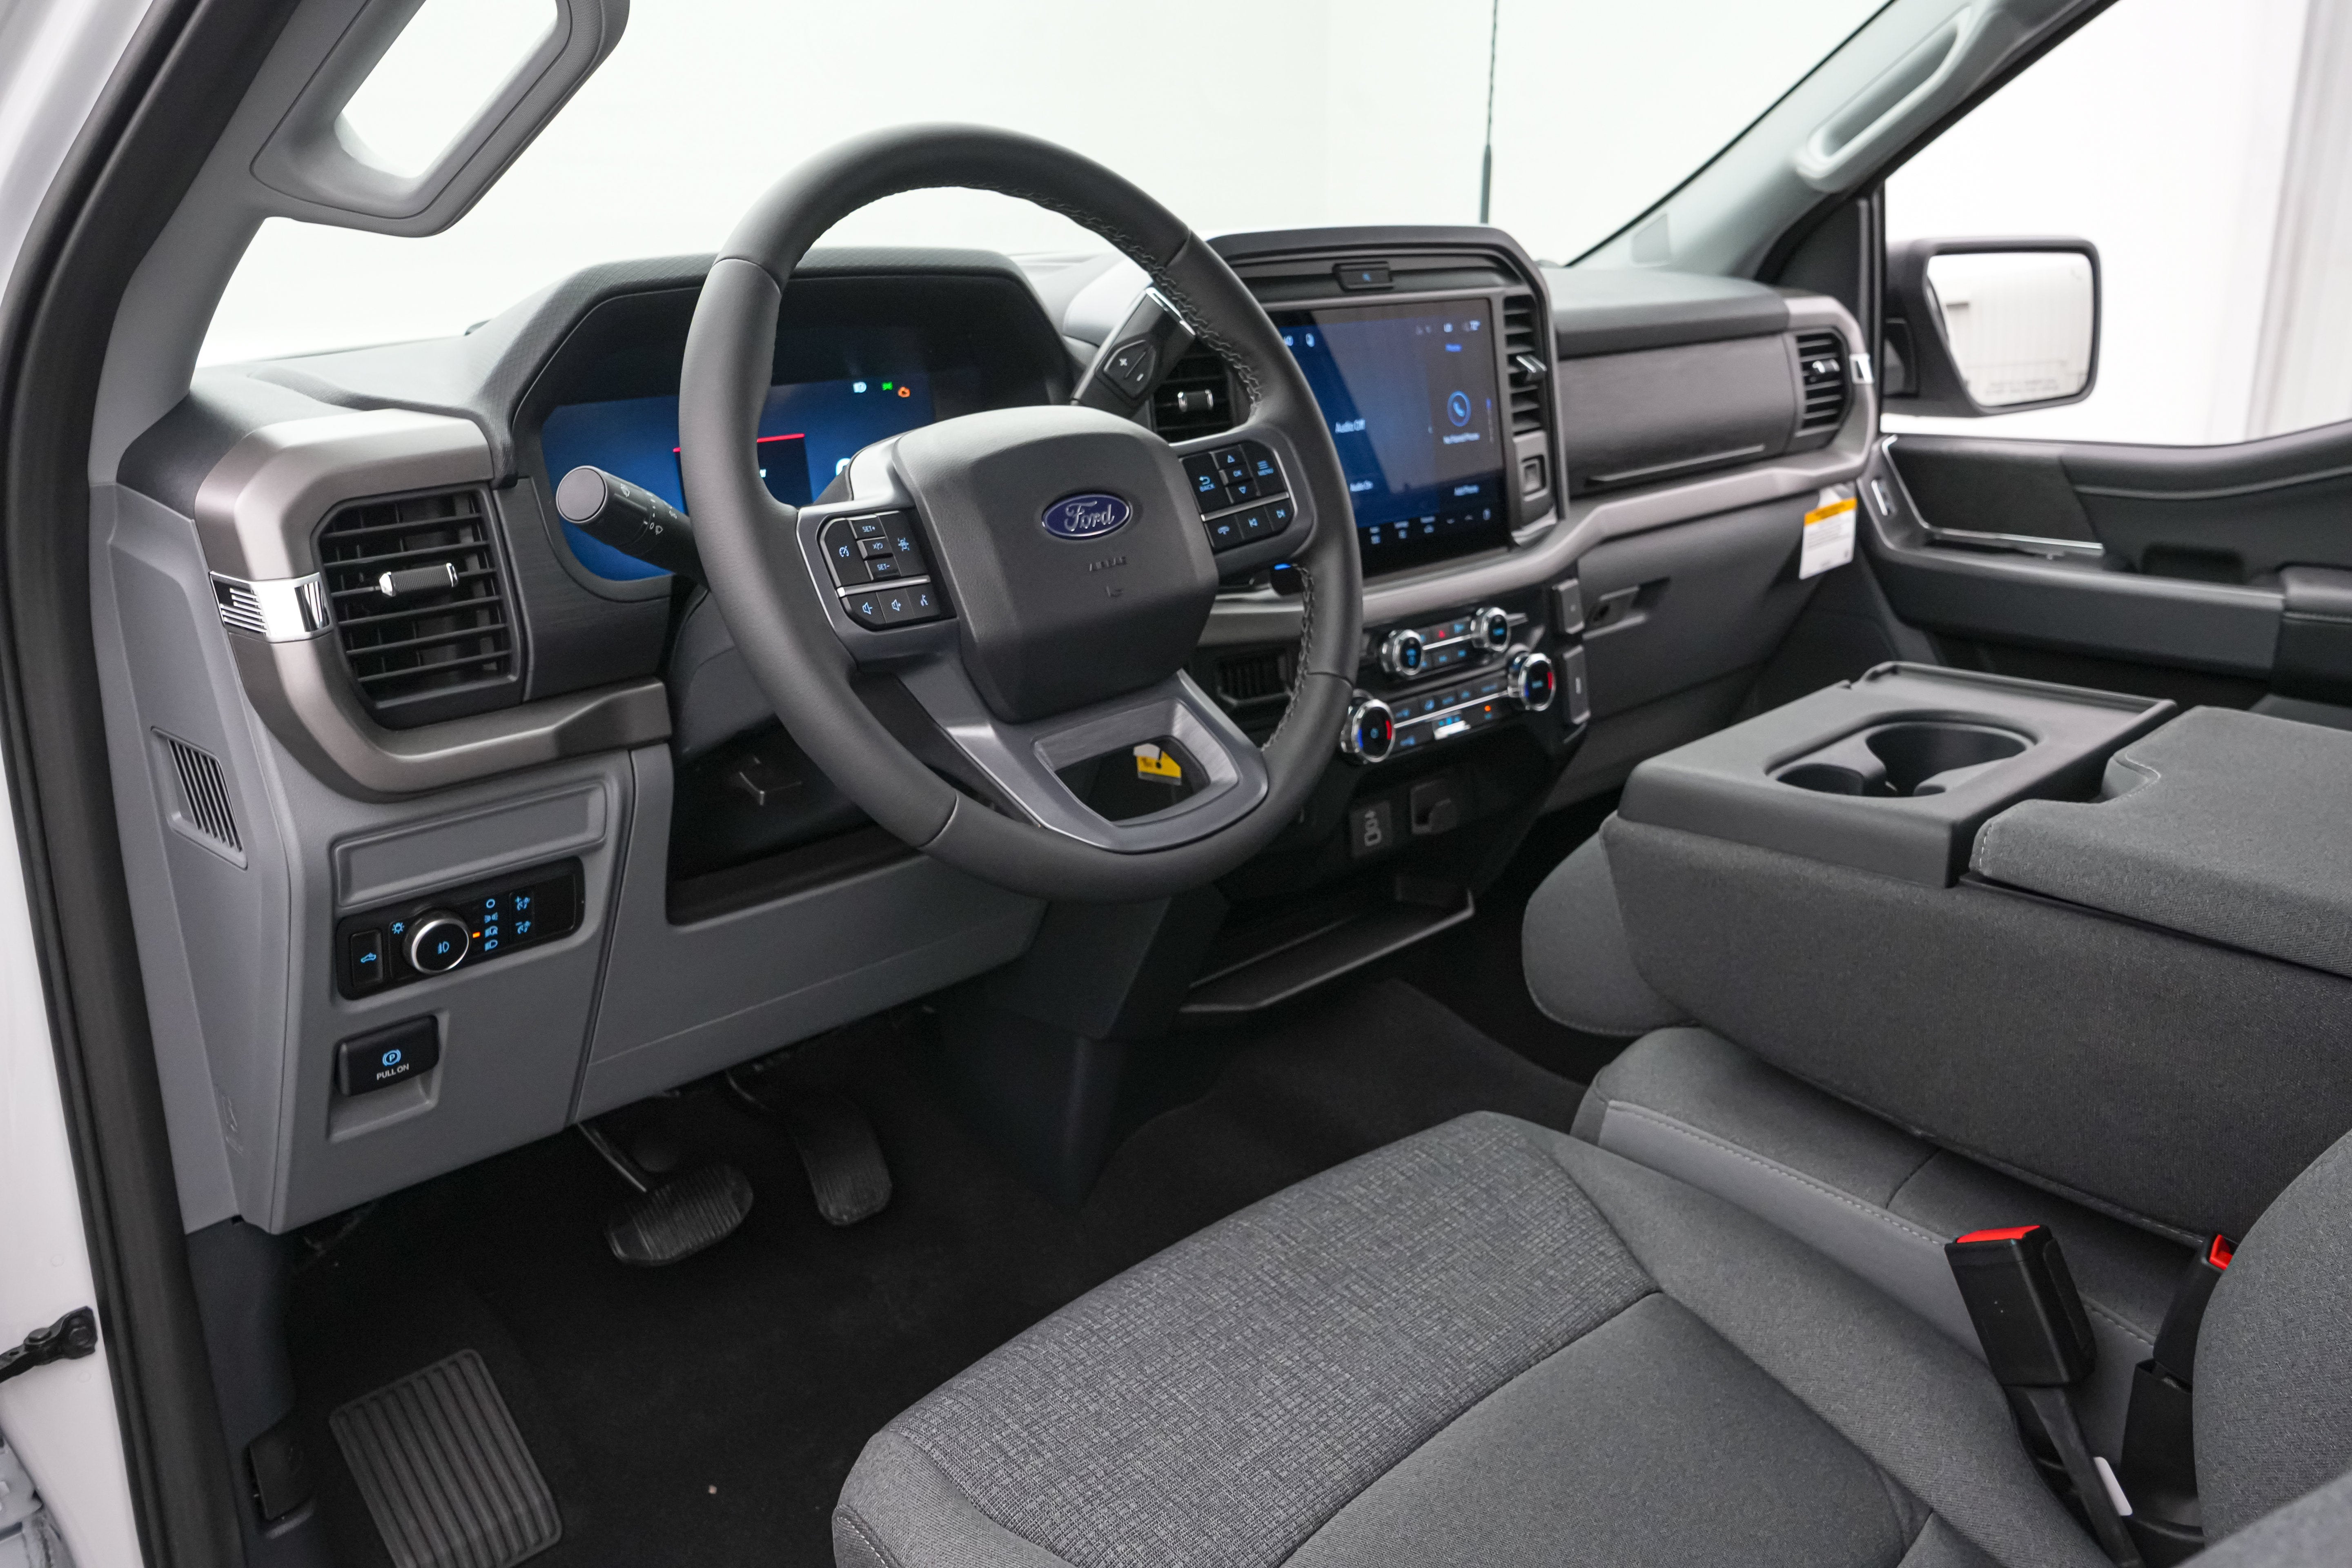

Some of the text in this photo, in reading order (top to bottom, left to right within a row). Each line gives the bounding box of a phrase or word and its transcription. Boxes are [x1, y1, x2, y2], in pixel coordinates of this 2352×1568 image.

[1064, 501, 1115, 532] Ford
[376, 1062, 410, 1081] PULL ON
